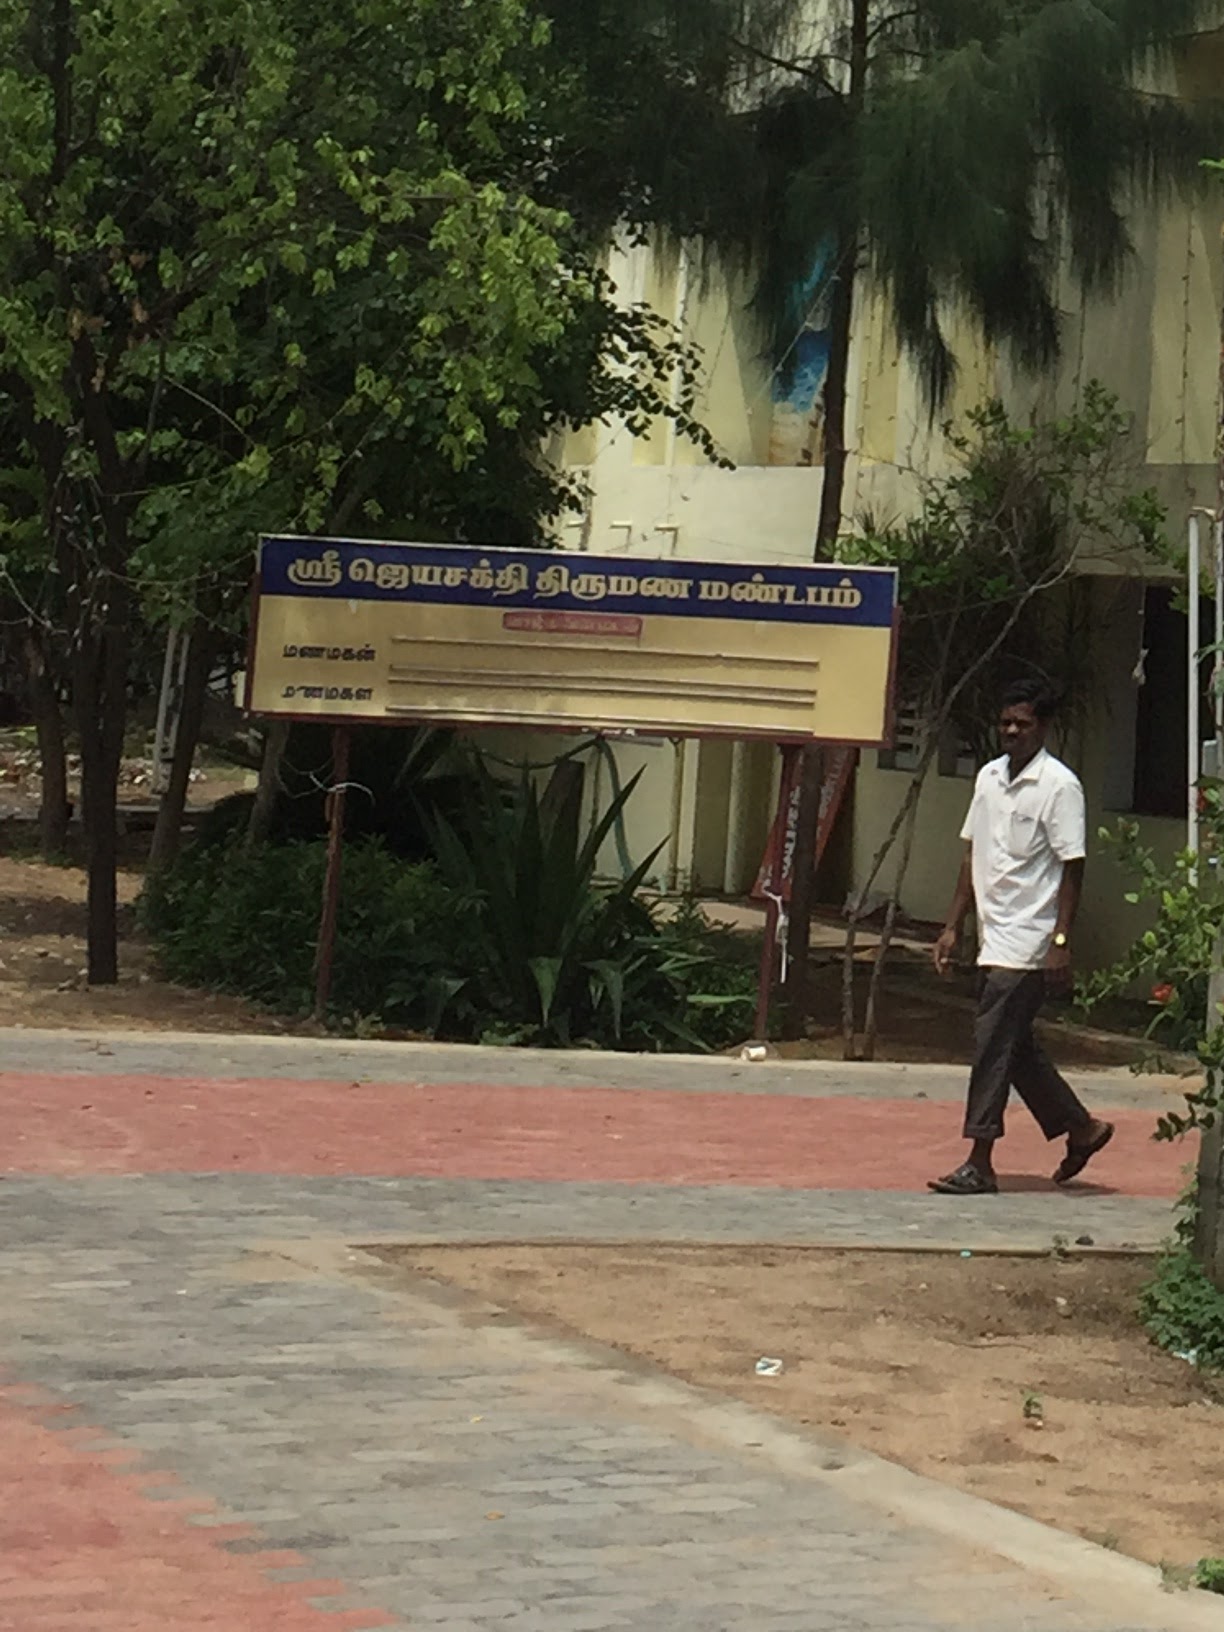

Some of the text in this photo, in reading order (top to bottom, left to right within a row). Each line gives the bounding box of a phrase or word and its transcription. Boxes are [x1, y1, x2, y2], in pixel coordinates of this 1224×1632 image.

[288, 549, 862, 609] ஸ்ரீ ஜெயசக்தி திருமண மண்டபம்
